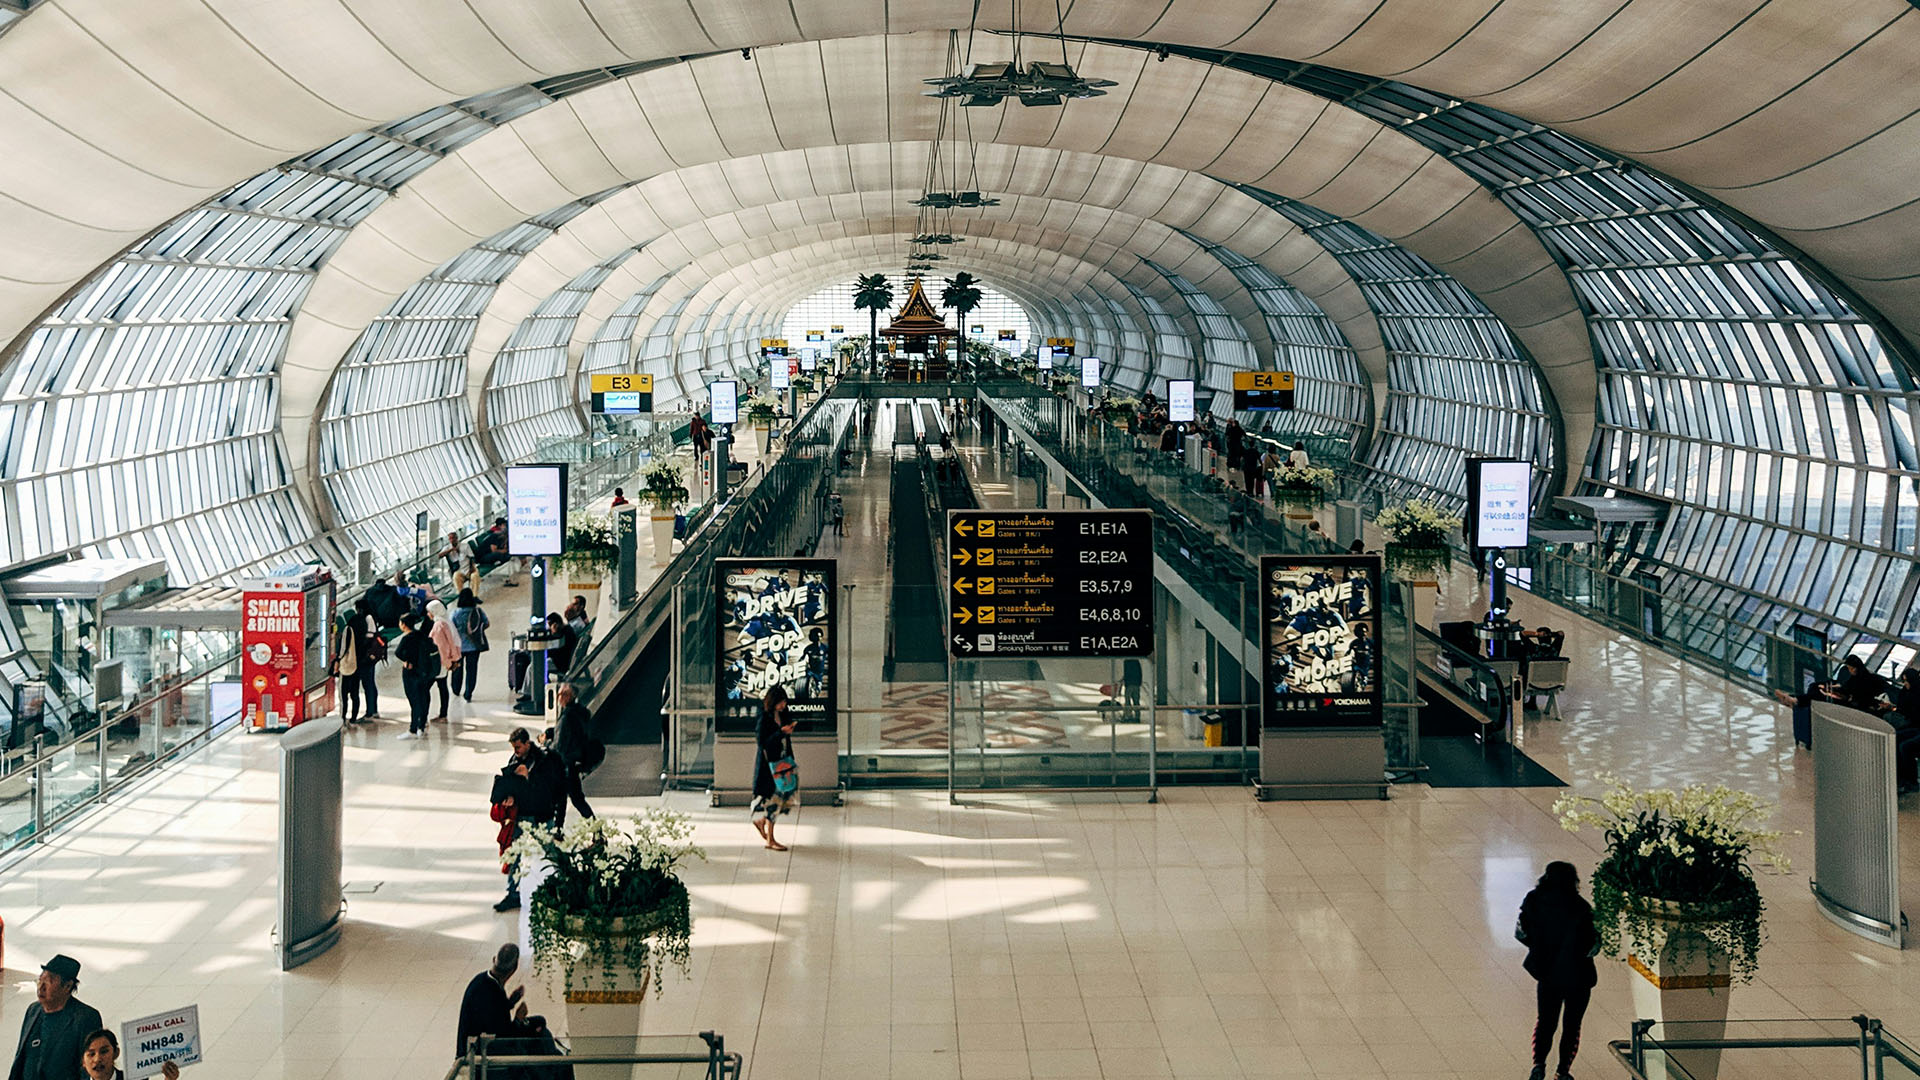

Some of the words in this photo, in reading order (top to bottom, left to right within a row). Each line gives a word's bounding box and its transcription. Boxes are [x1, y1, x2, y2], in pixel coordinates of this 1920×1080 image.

[612, 376, 631, 389] E3
[1254, 374, 1273, 387] E4
[1080, 522, 1128, 537] E1,E1A
[1079, 551, 1128, 565] E2,E2A
[1079, 580, 1133, 594] E3,5,7,9
[742, 585, 808, 620] DRIVE
[1289, 581, 1353, 615] DRIVE
[247, 599, 300, 617] SNACK
[1080, 608, 1141, 622] E4,6,8,10
[247, 617, 301, 633] &DRINK
[1080, 636, 1139, 650] E1A,E2A
[748, 661, 807, 691] MORE
[1294, 655, 1353, 685] MORE
[787, 704, 826, 712] YOKOHAMA
[1333, 698, 1372, 706] YOKOHAMA
[136, 1022, 162, 1034] FINAL
[164, 1016, 186, 1028] CALL
[141, 1032, 184, 1053] NH848
